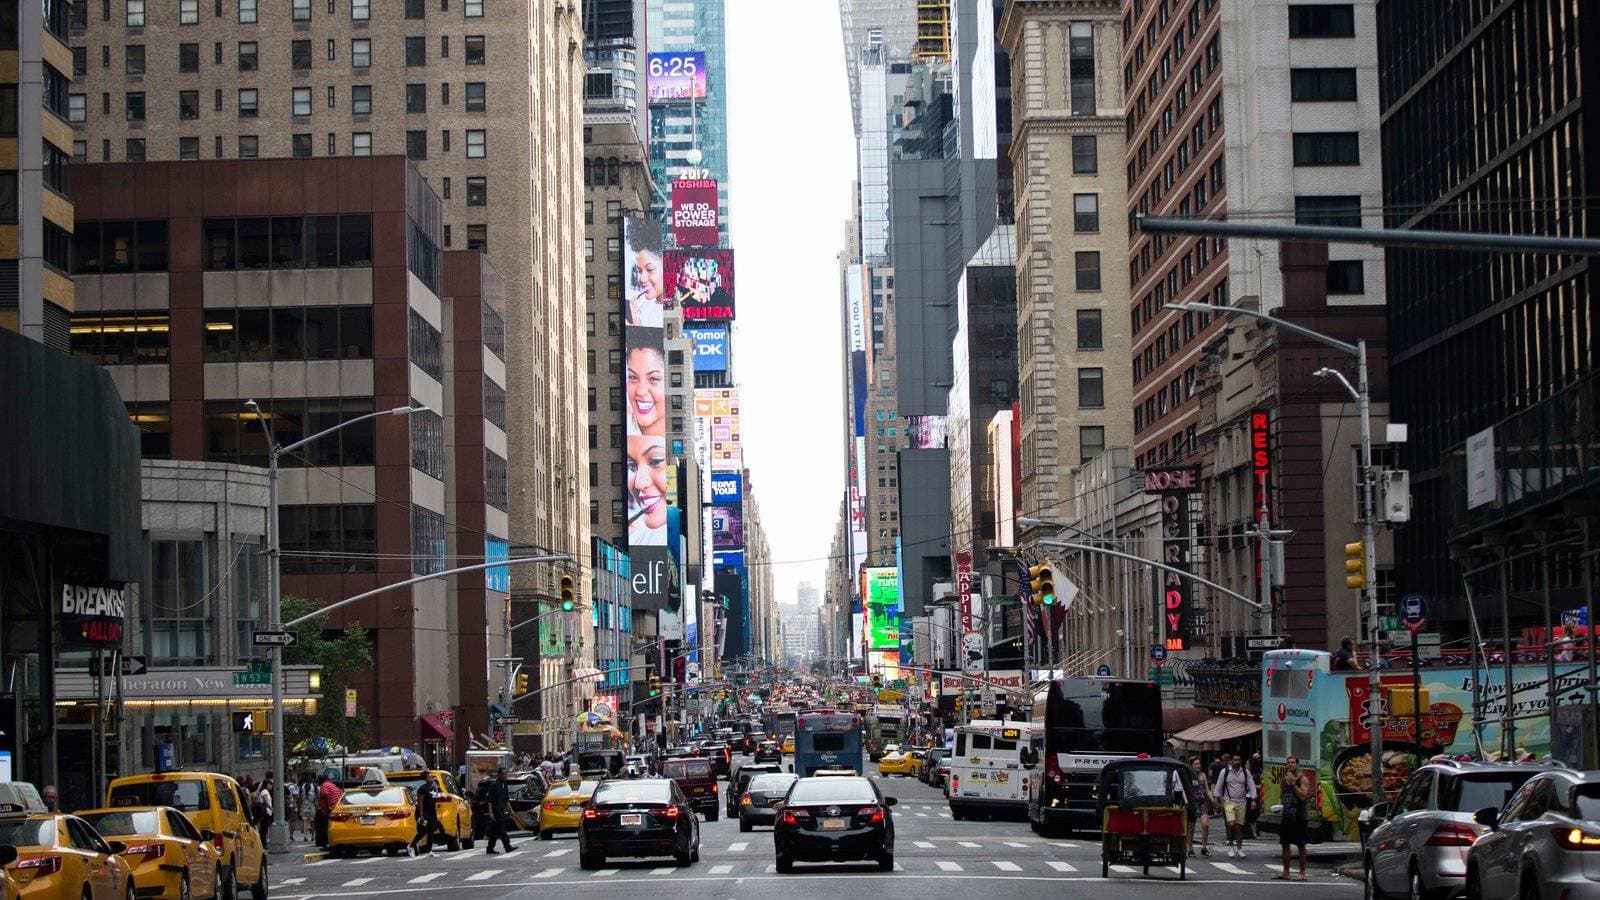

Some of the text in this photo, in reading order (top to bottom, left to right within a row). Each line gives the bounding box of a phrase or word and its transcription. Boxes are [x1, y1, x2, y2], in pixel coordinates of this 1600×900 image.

[649, 57, 696, 77] 6:25
[680, 169, 709, 180] 2017
[674, 211, 716, 219] POWER
[675, 219, 716, 227] STORAGE
[683, 306, 733, 318] SHIBA
[852, 301, 861, 320] YOU
[697, 345, 722, 355] TDK
[713, 520, 720, 529] 3
[1166, 638, 1182, 650] BAR
[250, 673, 261, 682] 53
[113, 677, 187, 690] heraton
[194, 677, 227, 690] New
